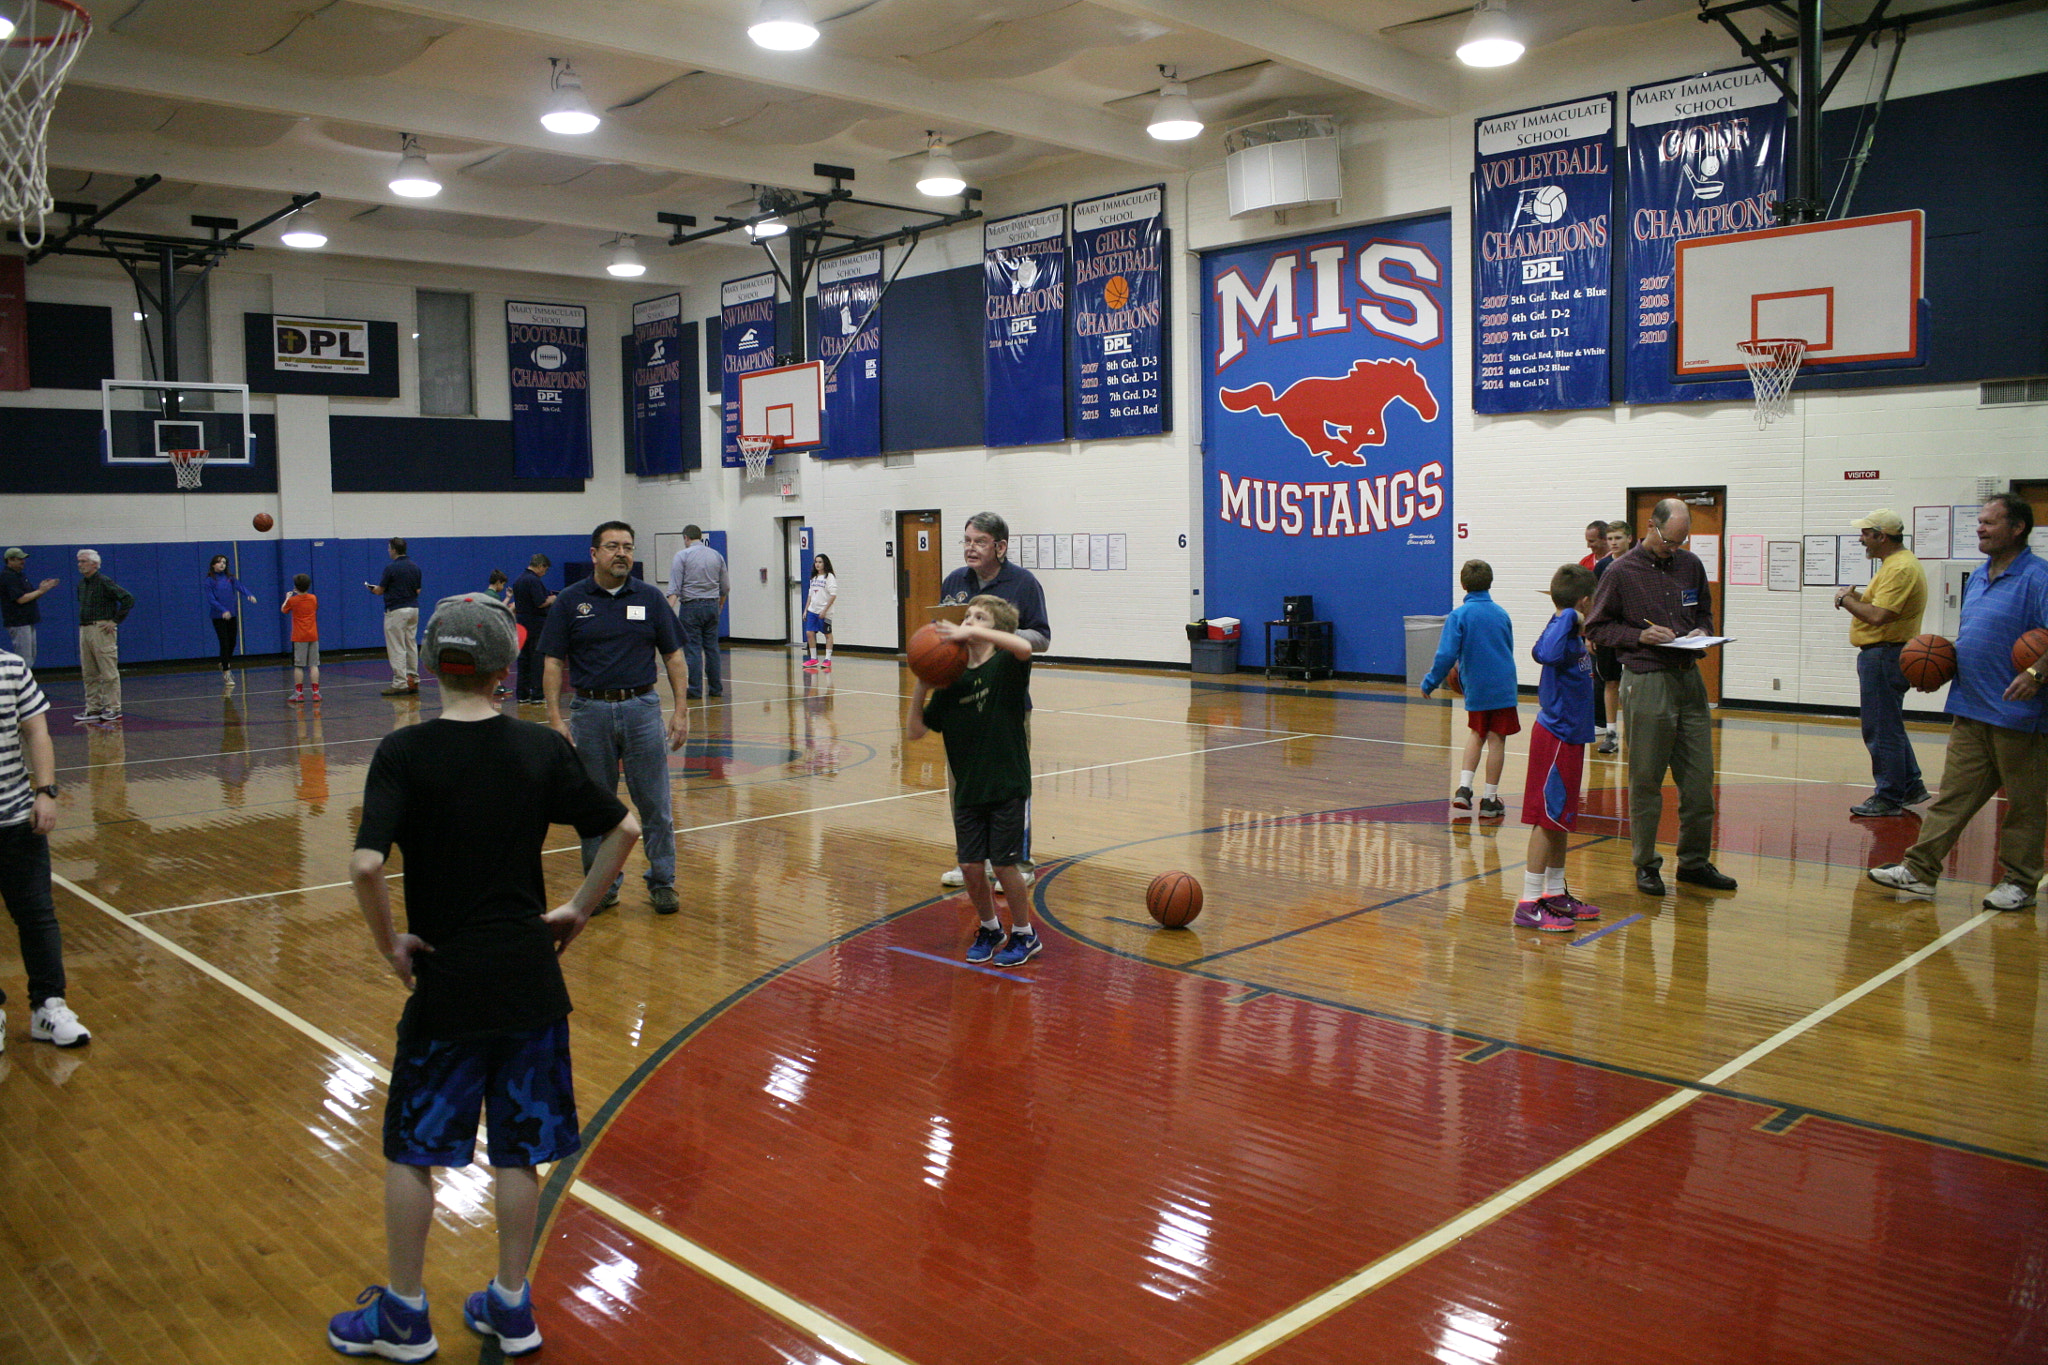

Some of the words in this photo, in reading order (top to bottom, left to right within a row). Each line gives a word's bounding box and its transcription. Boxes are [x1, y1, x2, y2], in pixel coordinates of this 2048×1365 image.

[1635, 88, 1676, 106] MARY
[1681, 68, 1776, 97] IMMACULAT
[1674, 96, 1736, 117] SCHOOL
[1482, 119, 1519, 136] MARY
[1523, 102, 1607, 128] IMMACULATE
[1517, 127, 1571, 146] SCHOOL
[1661, 117, 1749, 161] GOLF
[1481, 143, 1609, 191] VOLLEYBALL
[1076, 205, 1101, 217] MARY
[1102, 191, 1158, 212] IMMACULATE
[987, 224, 1010, 237] MARY
[1011, 213, 1060, 231] IMMACULATE
[1099, 211, 1133, 225] SCHOOL
[1634, 190, 1777, 241] CHAMPIONS
[1008, 230, 1040, 244] SCHOOL
[1095, 228, 1137, 254] GIRLS
[1482, 214, 1607, 262] CHAMPIONS
[1011, 238, 1064, 258] VOLLEYBALL
[1075, 246, 1159, 286] BASKETBALL
[1522, 260, 1563, 281] DPL
[1640, 275, 1669, 291] 2007
[986, 282, 1064, 321] CHAMPIONS
[1214, 237, 1444, 376] MIS
[1482, 295, 1508, 309] 2007
[1511, 295, 1526, 306] 5th
[1529, 292, 1547, 303] Grd.
[1551, 290, 1570, 301] Red
[1573, 289, 1582, 299] &
[1586, 287, 1607, 297] Blue
[1639, 294, 1669, 309] 2008
[724, 300, 773, 331] SWIMMING
[1076, 299, 1159, 337] CHAMPIONS
[1482, 313, 1508, 327] 2009
[1511, 313, 1527, 323] 6th
[1530, 310, 1547, 321] Grd.
[1551, 308, 1570, 319] D-2
[1639, 311, 1669, 326] 2009
[636, 317, 678, 345] SWIMMING
[1011, 318, 1037, 334] DPL
[1482, 331, 1509, 345] 2009
[1511, 331, 1527, 341] 7th
[1530, 329, 1547, 339] Grd.
[1551, 327, 1570, 338] D-1
[277, 327, 364, 359] DPL
[510, 324, 585, 349] FOOTBALL
[820, 327, 879, 357] CHAMPIONS
[1104, 336, 1132, 353] DPL
[1639, 330, 1667, 344] 2010
[724, 345, 775, 374] CHAMPIONS
[1106, 360, 1118, 371] 8th
[1121, 358, 1139, 369] Grd.
[1142, 356, 1158, 367] D-3
[1482, 353, 1504, 364] 2011
[1509, 354, 1521, 362] 5th
[1538, 350, 1553, 359] Red,
[1555, 349, 1573, 358] Blue
[1575, 349, 1582, 357] &
[1583, 347, 1606, 356] White
[511, 367, 587, 389] CHAMPIONS
[635, 360, 680, 386] CHAMPIONS
[1107, 375, 1119, 386] 8th
[1121, 373, 1140, 384] Grd.
[1142, 371, 1158, 382] D-1
[1482, 366, 1504, 377] 2012
[1509, 367, 1521, 375] 6th
[1538, 364, 1550, 373] D-2
[1552, 363, 1570, 372] Blue
[648, 387, 664, 398] DPL
[1509, 381, 1521, 389] 8th
[1538, 378, 1549, 386] D-1
[537, 391, 562, 401] DPL
[1081, 394, 1099, 404] 2012
[1109, 391, 1121, 402] 7th
[1122, 390, 1141, 401] Grd.
[1142, 388, 1157, 399] D-2
[1082, 409, 1099, 420] 2015
[1110, 408, 1121, 418] 5th
[1122, 406, 1141, 416] Grd.
[1143, 404, 1158, 414] Red
[1847, 471, 1877, 479] VISITOR
[1218, 460, 1444, 537] MUSTANGS
[1178, 534, 1187, 548] 6
[1457, 523, 1468, 539] 5
[801, 536, 807, 548] 9
[920, 536, 927, 549] 8
